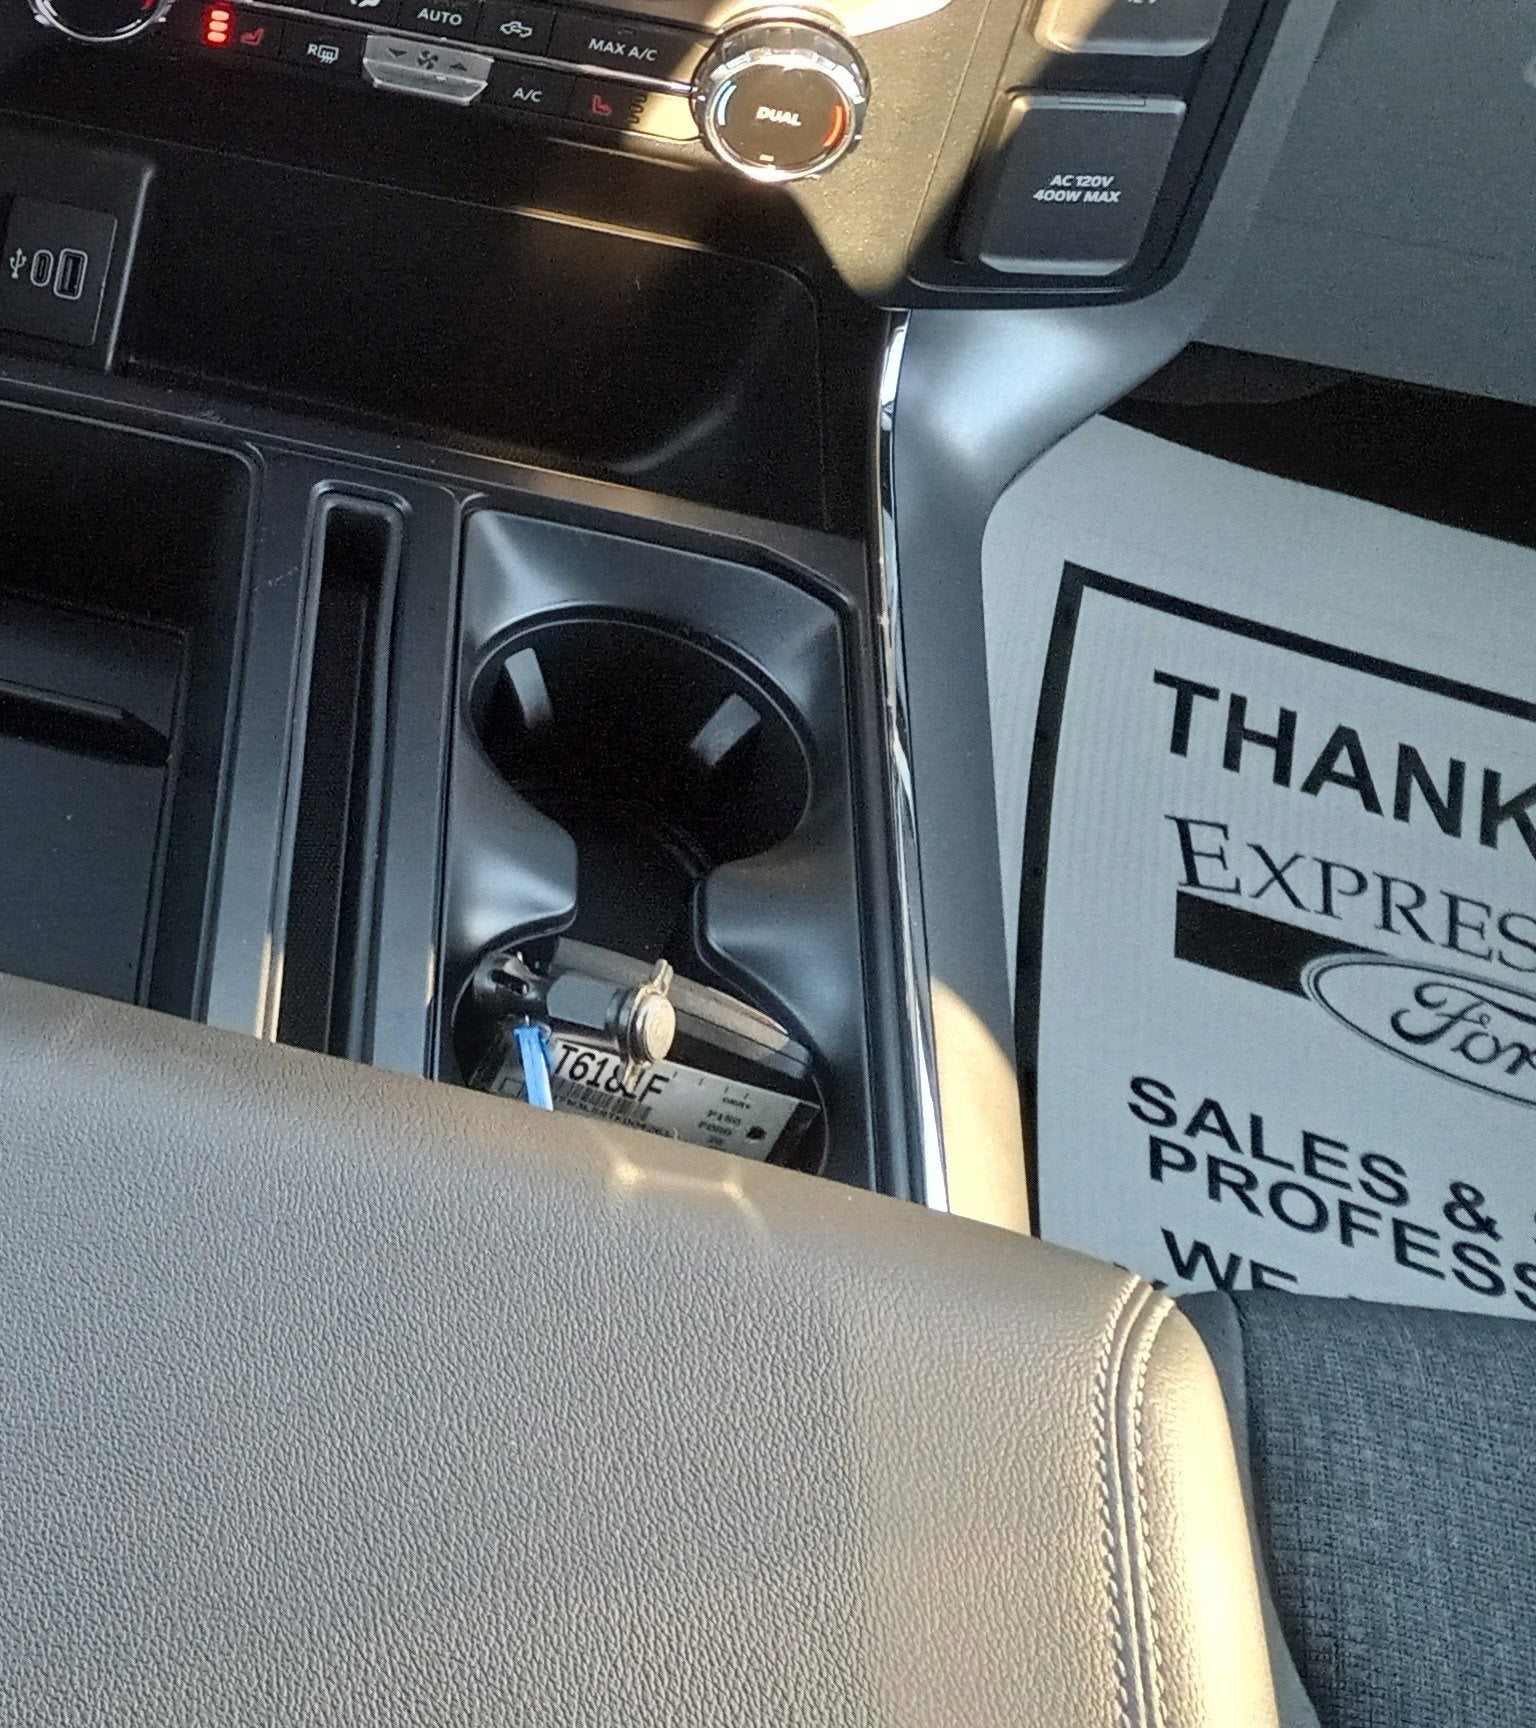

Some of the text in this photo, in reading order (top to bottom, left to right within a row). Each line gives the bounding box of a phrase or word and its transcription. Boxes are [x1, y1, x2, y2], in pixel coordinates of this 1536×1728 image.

[416, 8, 463, 27] AUTO
[588, 38, 658, 63] MAX A/C
[512, 87, 543, 104] A/C
[756, 106, 803, 128] DUAL
[1049, 174, 1115, 188] AC 120V
[1033, 188, 1122, 204] 400W MAX
[1153, 669, 1536, 862] THANK
[1127, 1075, 1504, 1243] SALES &
